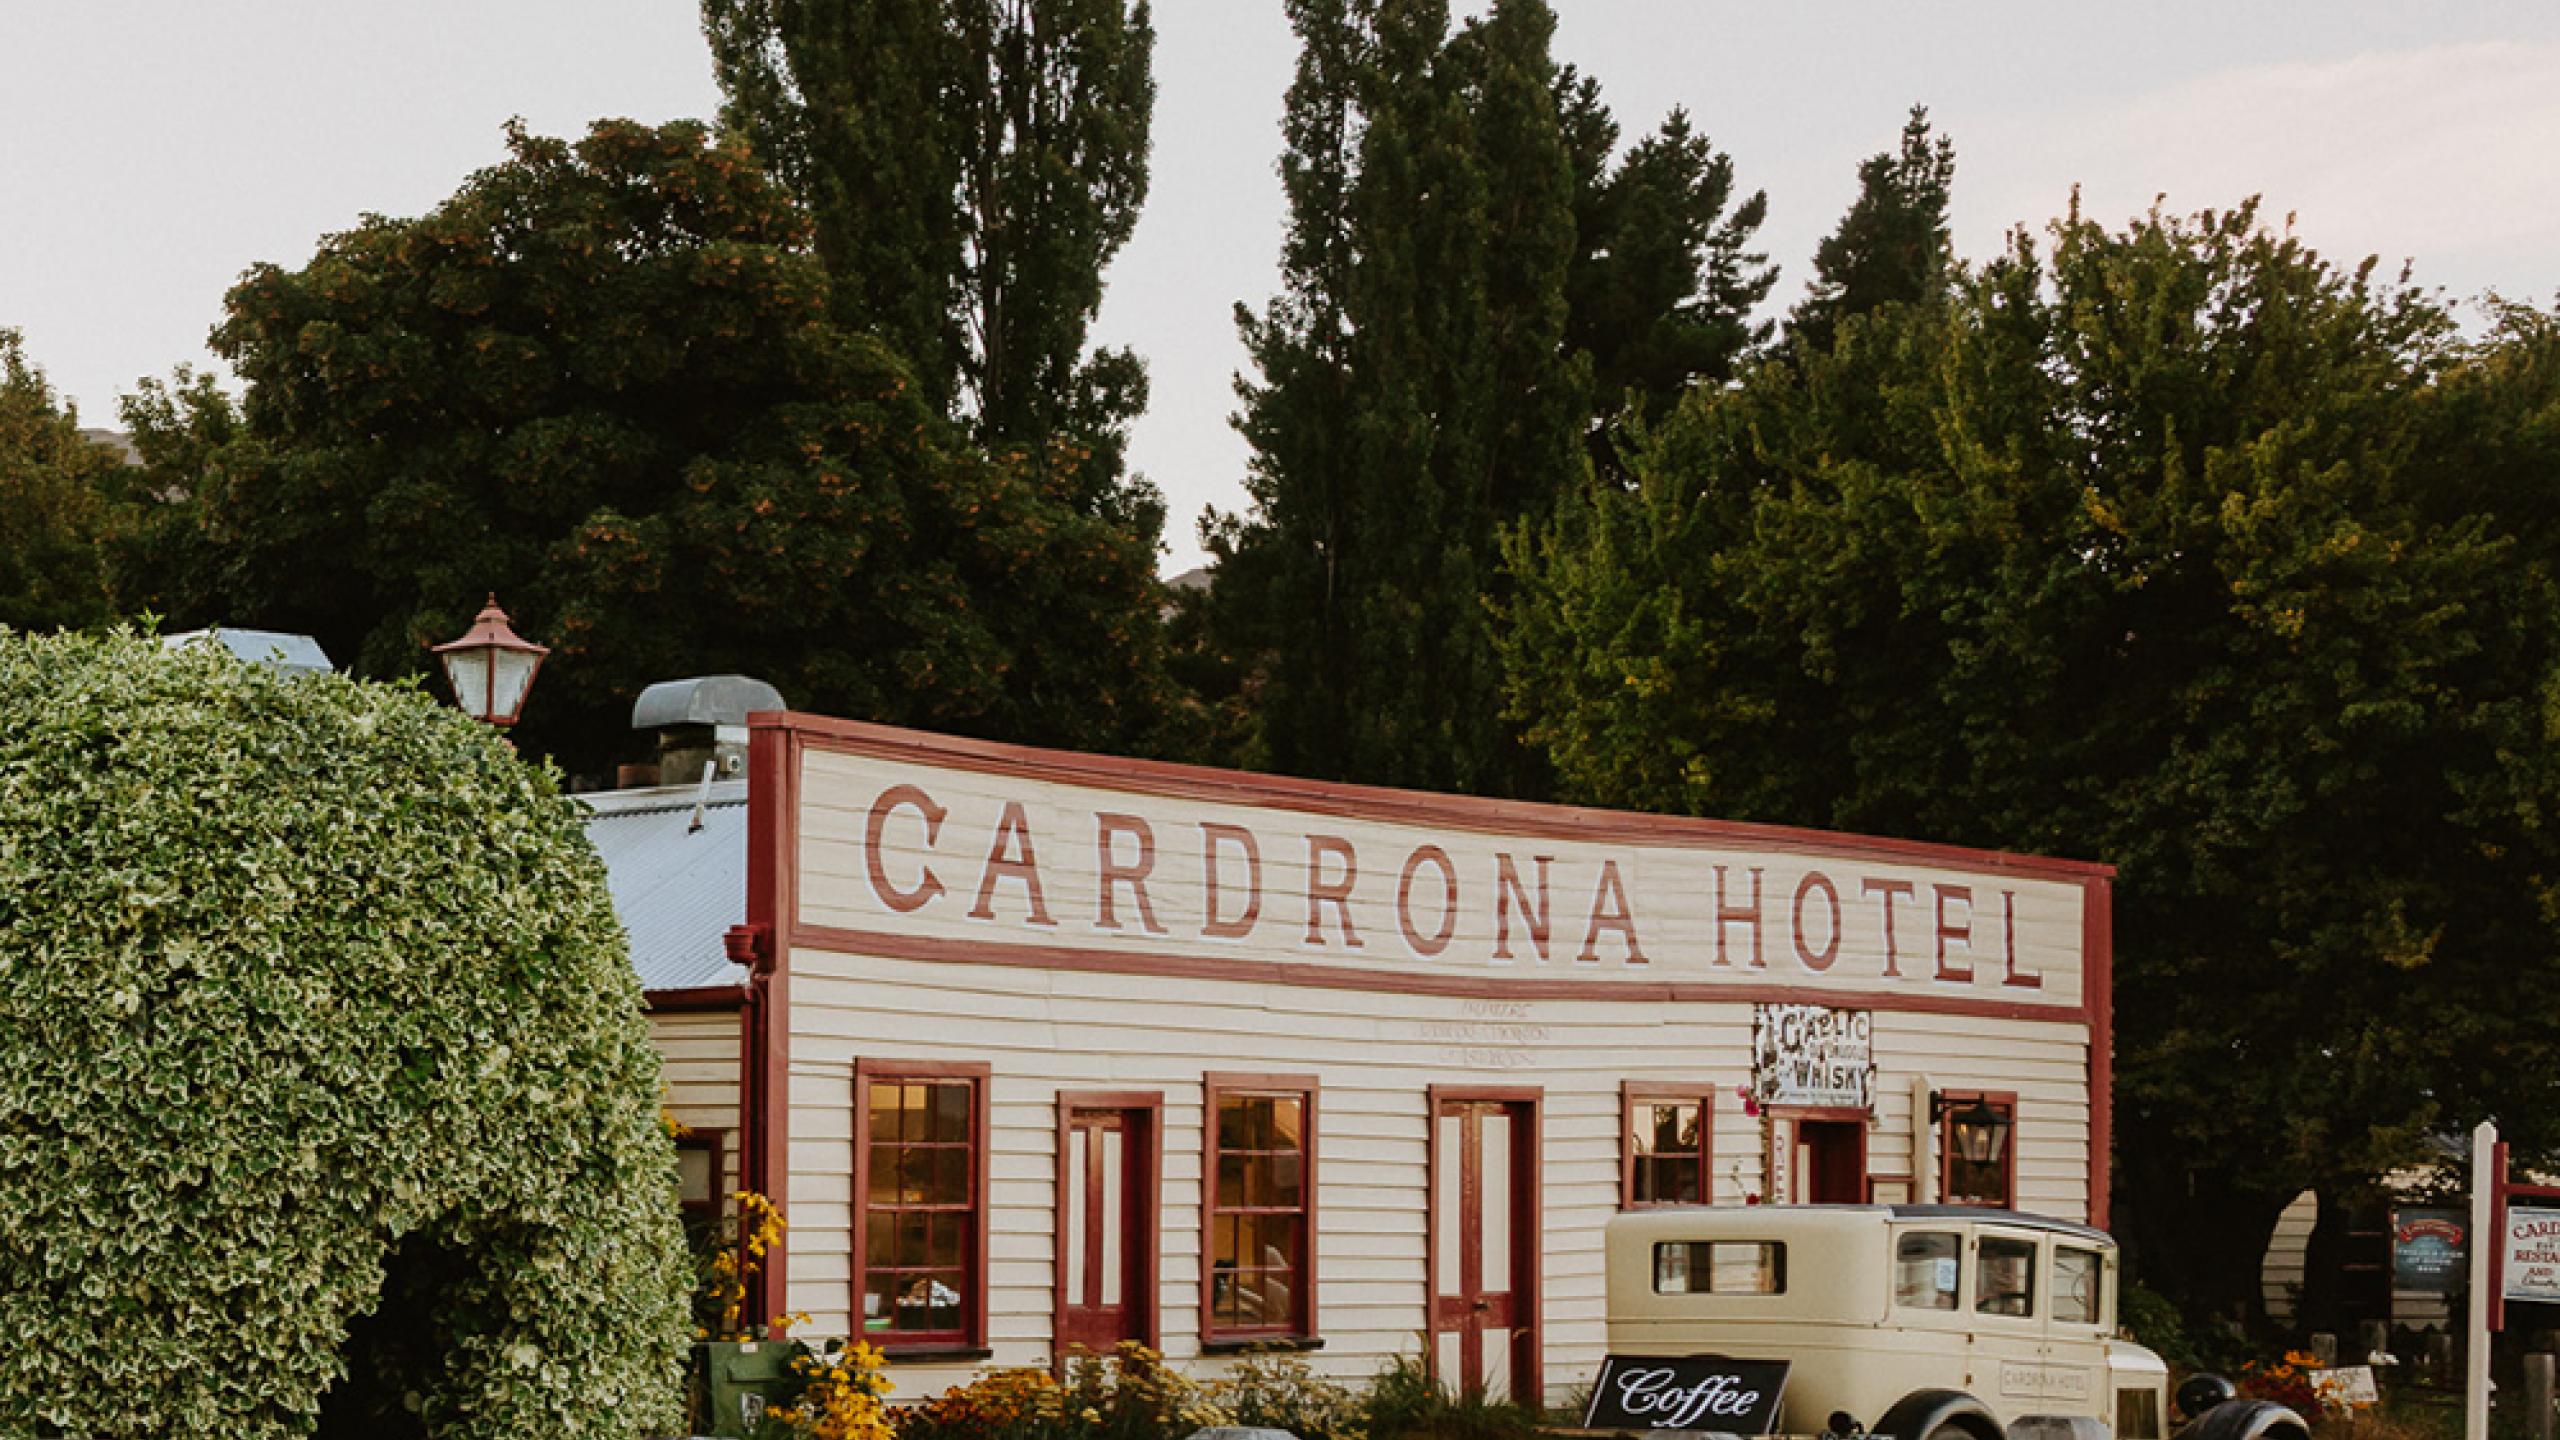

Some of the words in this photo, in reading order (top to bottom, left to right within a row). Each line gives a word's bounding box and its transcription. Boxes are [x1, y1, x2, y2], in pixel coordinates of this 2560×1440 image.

[865, 783, 1649, 964] CARDRONA
[1713, 865, 2043, 988] HOTEL
[1794, 1059, 1867, 1090] WHISKY
[1617, 1368, 1760, 1427] Coffee
